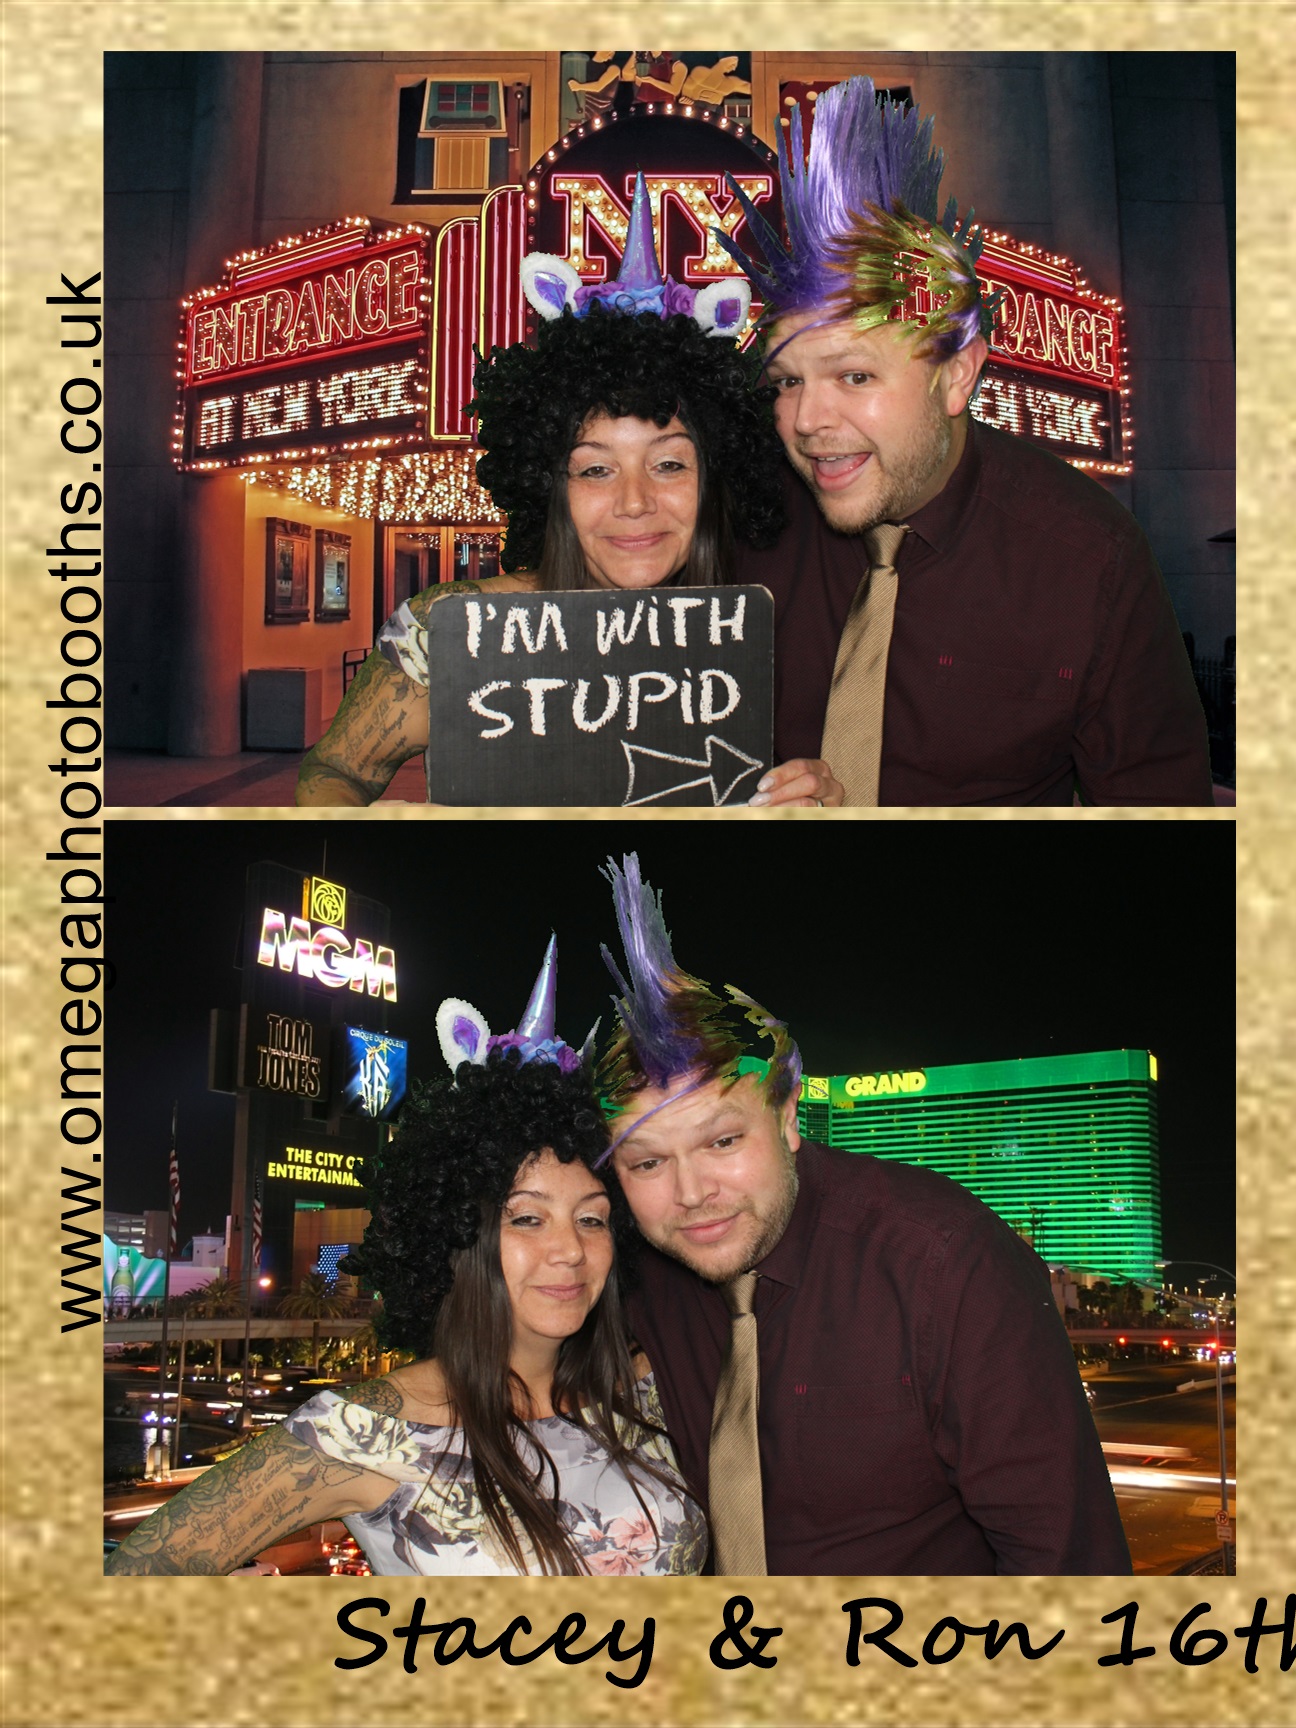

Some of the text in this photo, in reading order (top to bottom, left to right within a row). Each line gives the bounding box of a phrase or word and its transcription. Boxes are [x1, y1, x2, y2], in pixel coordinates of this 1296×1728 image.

[550, 173, 773, 282] NY
[191, 250, 421, 375] ENTRANCE
[316, 358, 420, 428] YORK
[465, 600, 569, 659] I'M
[257, 907, 398, 1003] MGM
[267, 1013, 313, 1057] TOM
[350, 1028, 374, 1042] CIRQUE
[383, 1037, 405, 1049] SOLEIL
[257, 1052, 321, 1098] JONES
[845, 1071, 927, 1097] GRAND
[267, 1161, 364, 1188] ENTERTAINME
[286, 1146, 313, 1164] THE
[315, 1151, 344, 1169] CITY
